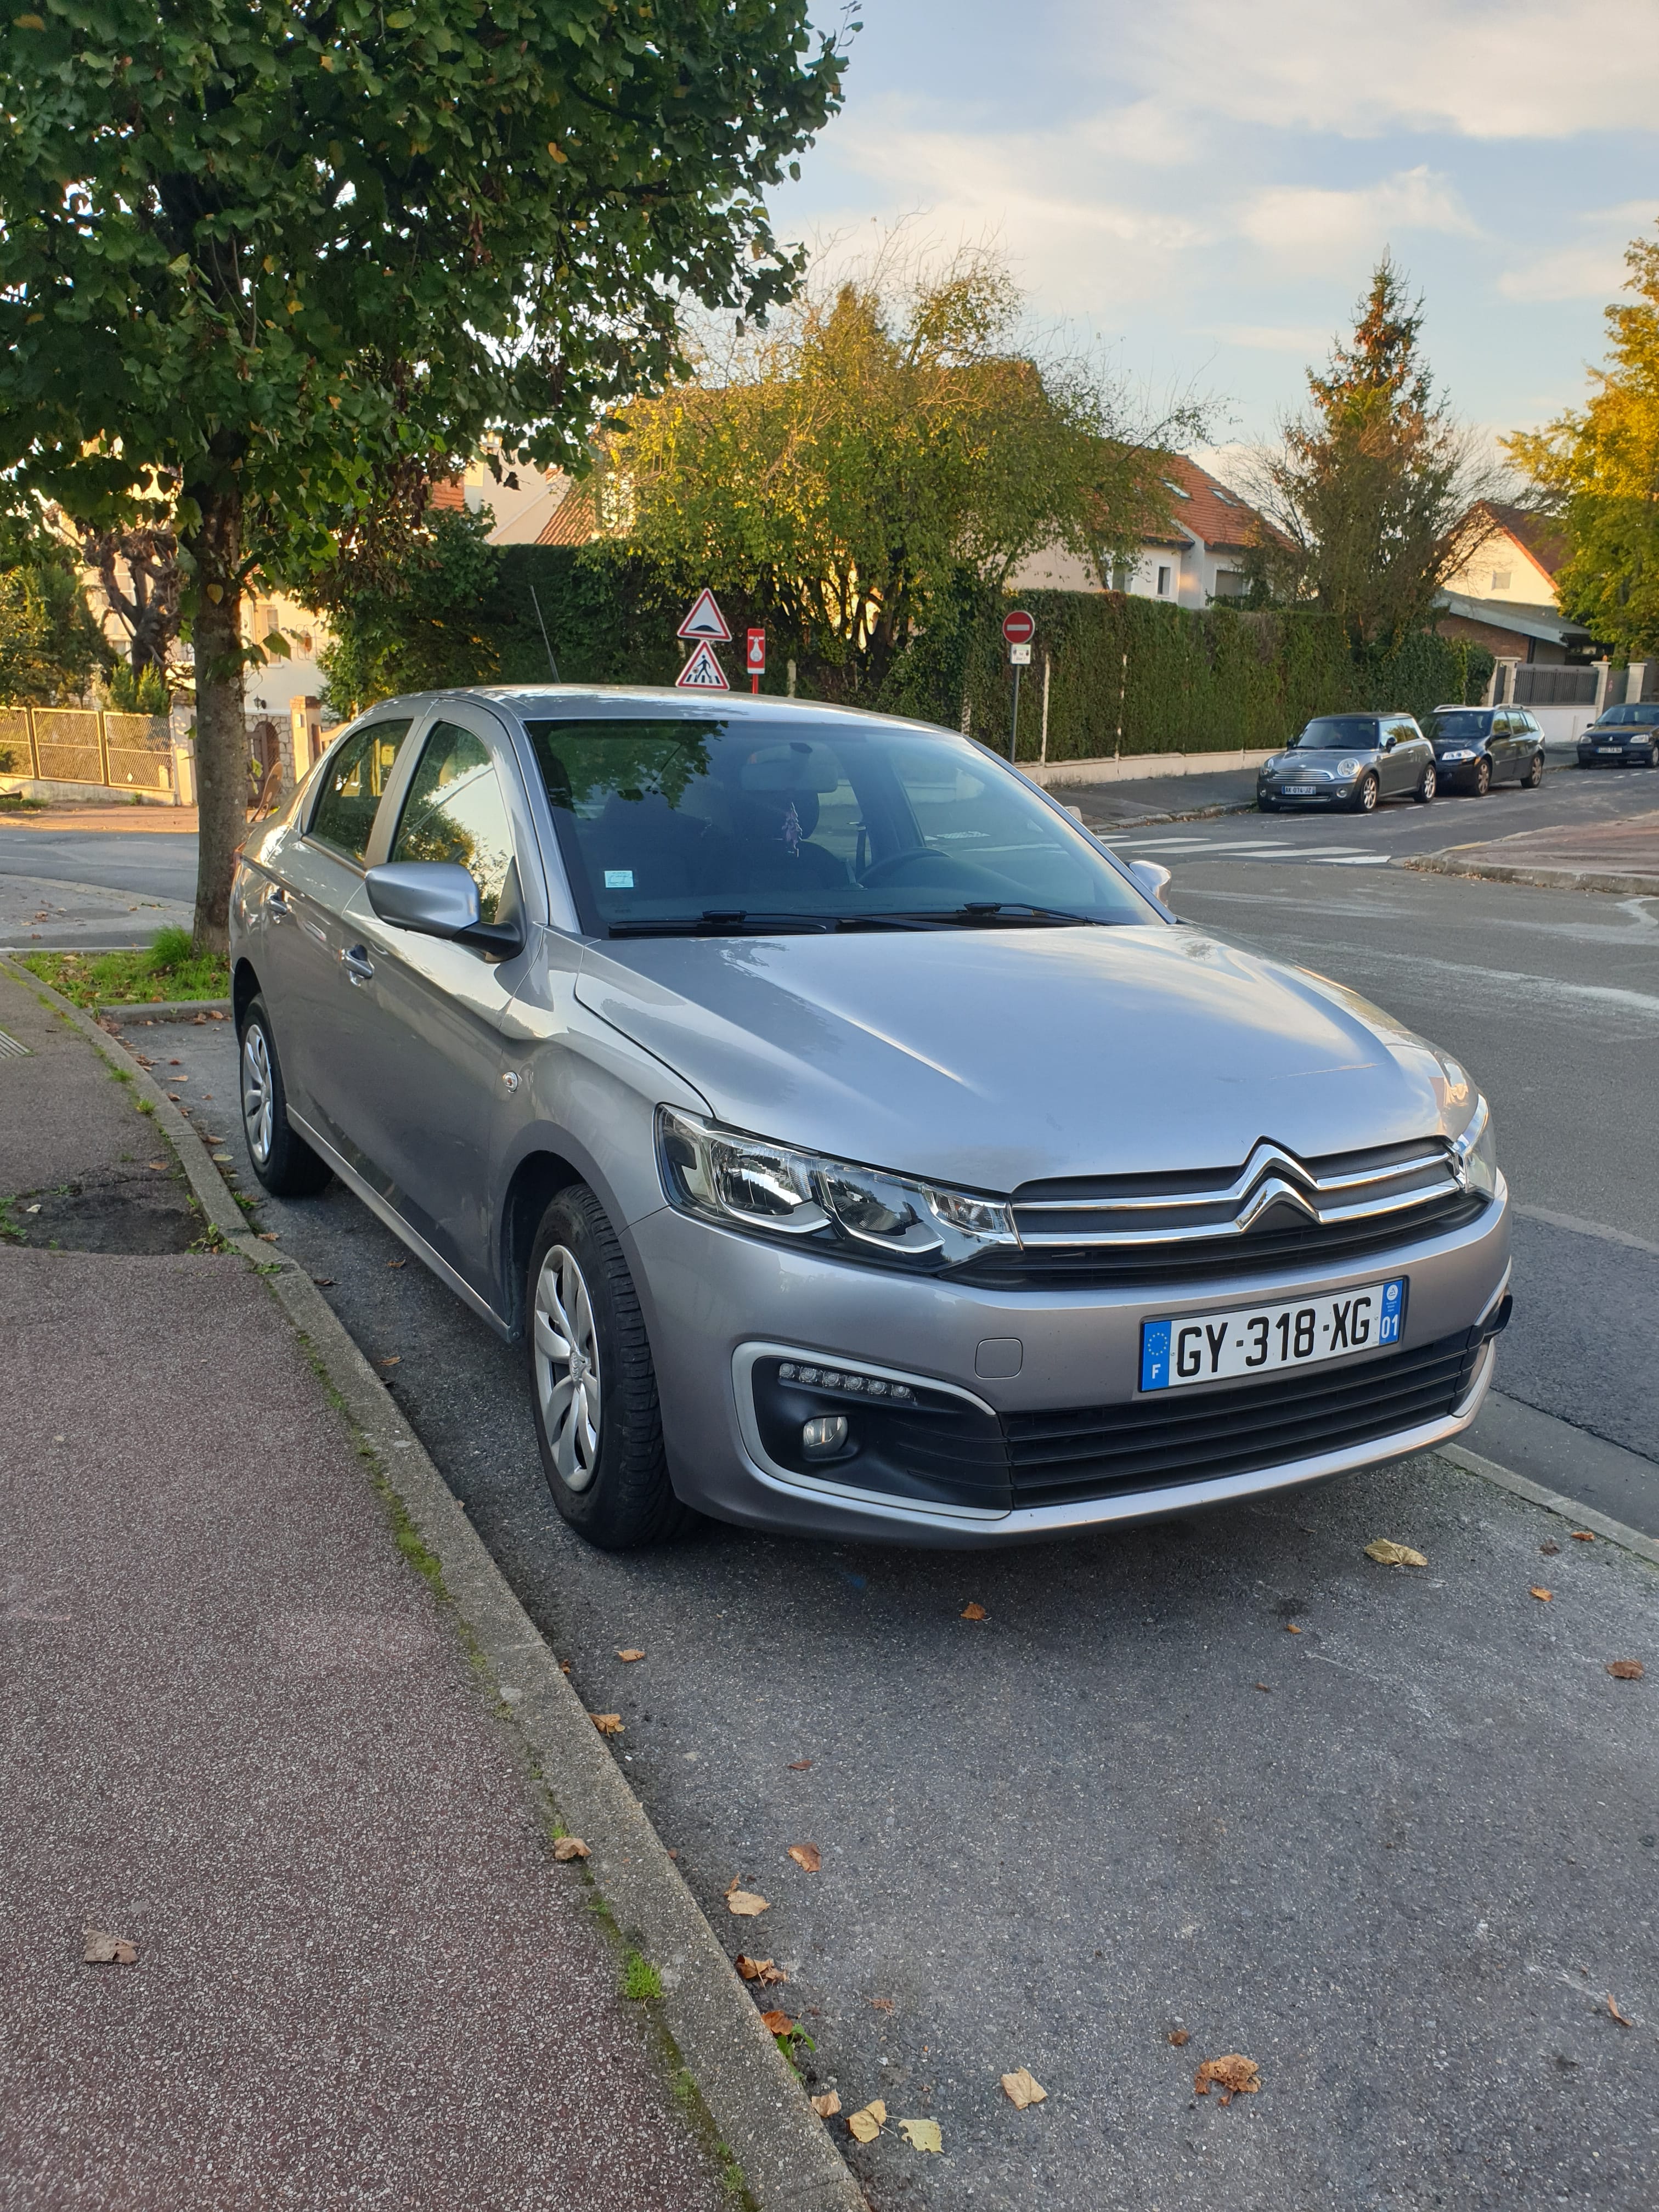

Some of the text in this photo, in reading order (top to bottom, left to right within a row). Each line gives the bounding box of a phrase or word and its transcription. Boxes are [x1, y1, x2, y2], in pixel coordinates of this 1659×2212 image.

[1177, 1297, 1371, 1378] GY-318-XG
[1381, 1314, 1398, 1338] 01
[1152, 1364, 1161, 1379] F
